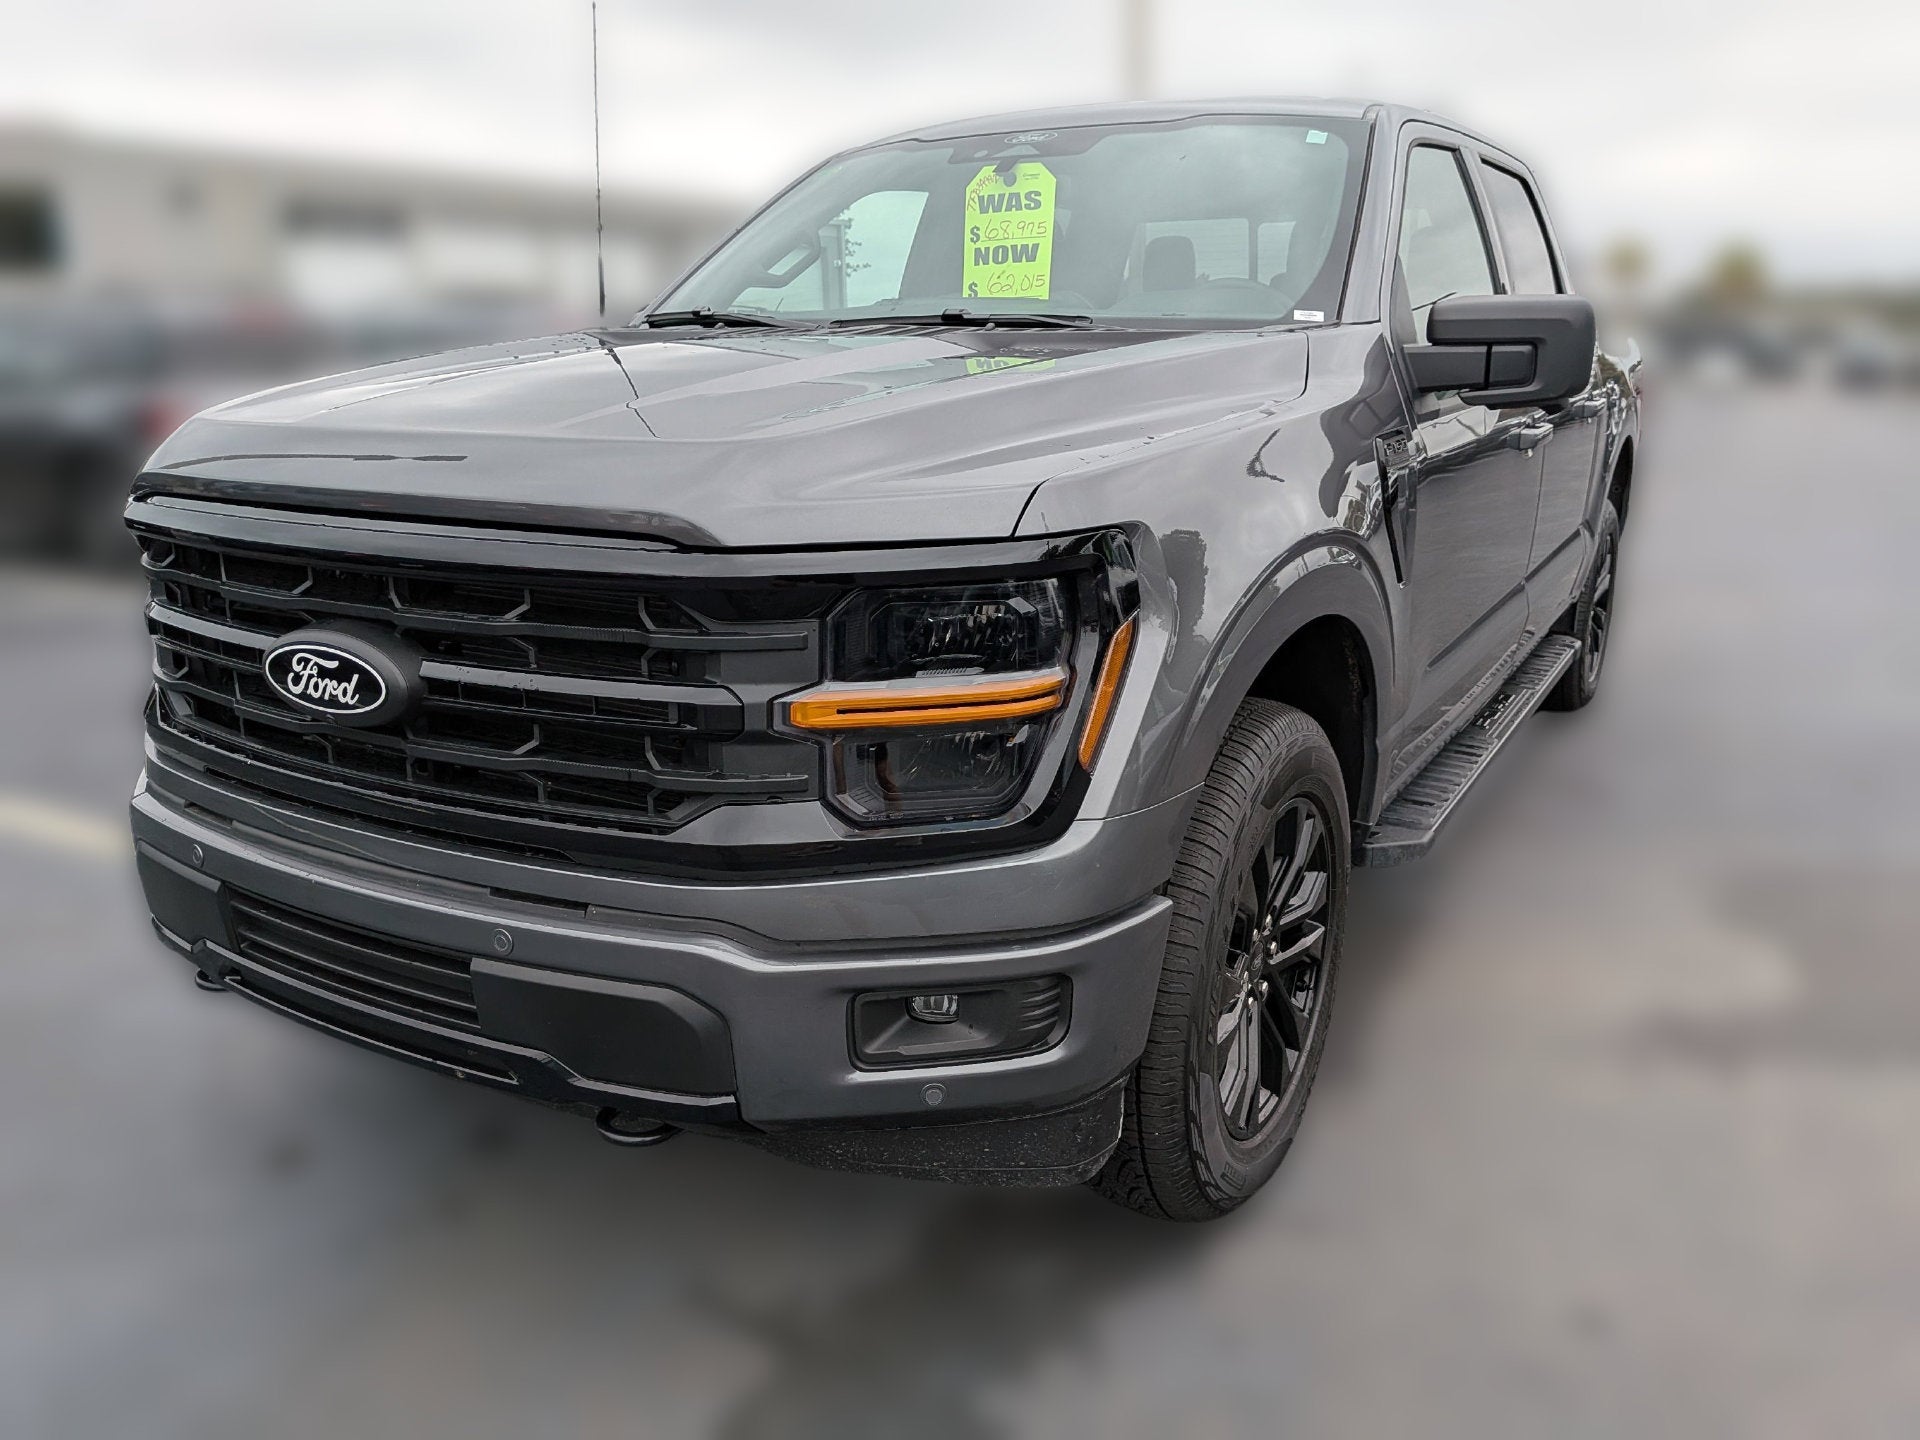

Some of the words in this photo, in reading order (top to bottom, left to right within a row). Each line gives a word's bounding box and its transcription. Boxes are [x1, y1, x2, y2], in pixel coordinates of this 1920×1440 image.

[978, 190, 1042, 215] WAS
[970, 225, 981, 244] $
[984, 219, 1047, 241] 68,975
[973, 243, 1040, 267] NOW
[968, 281, 979, 298] $
[287, 652, 360, 705] Ford
